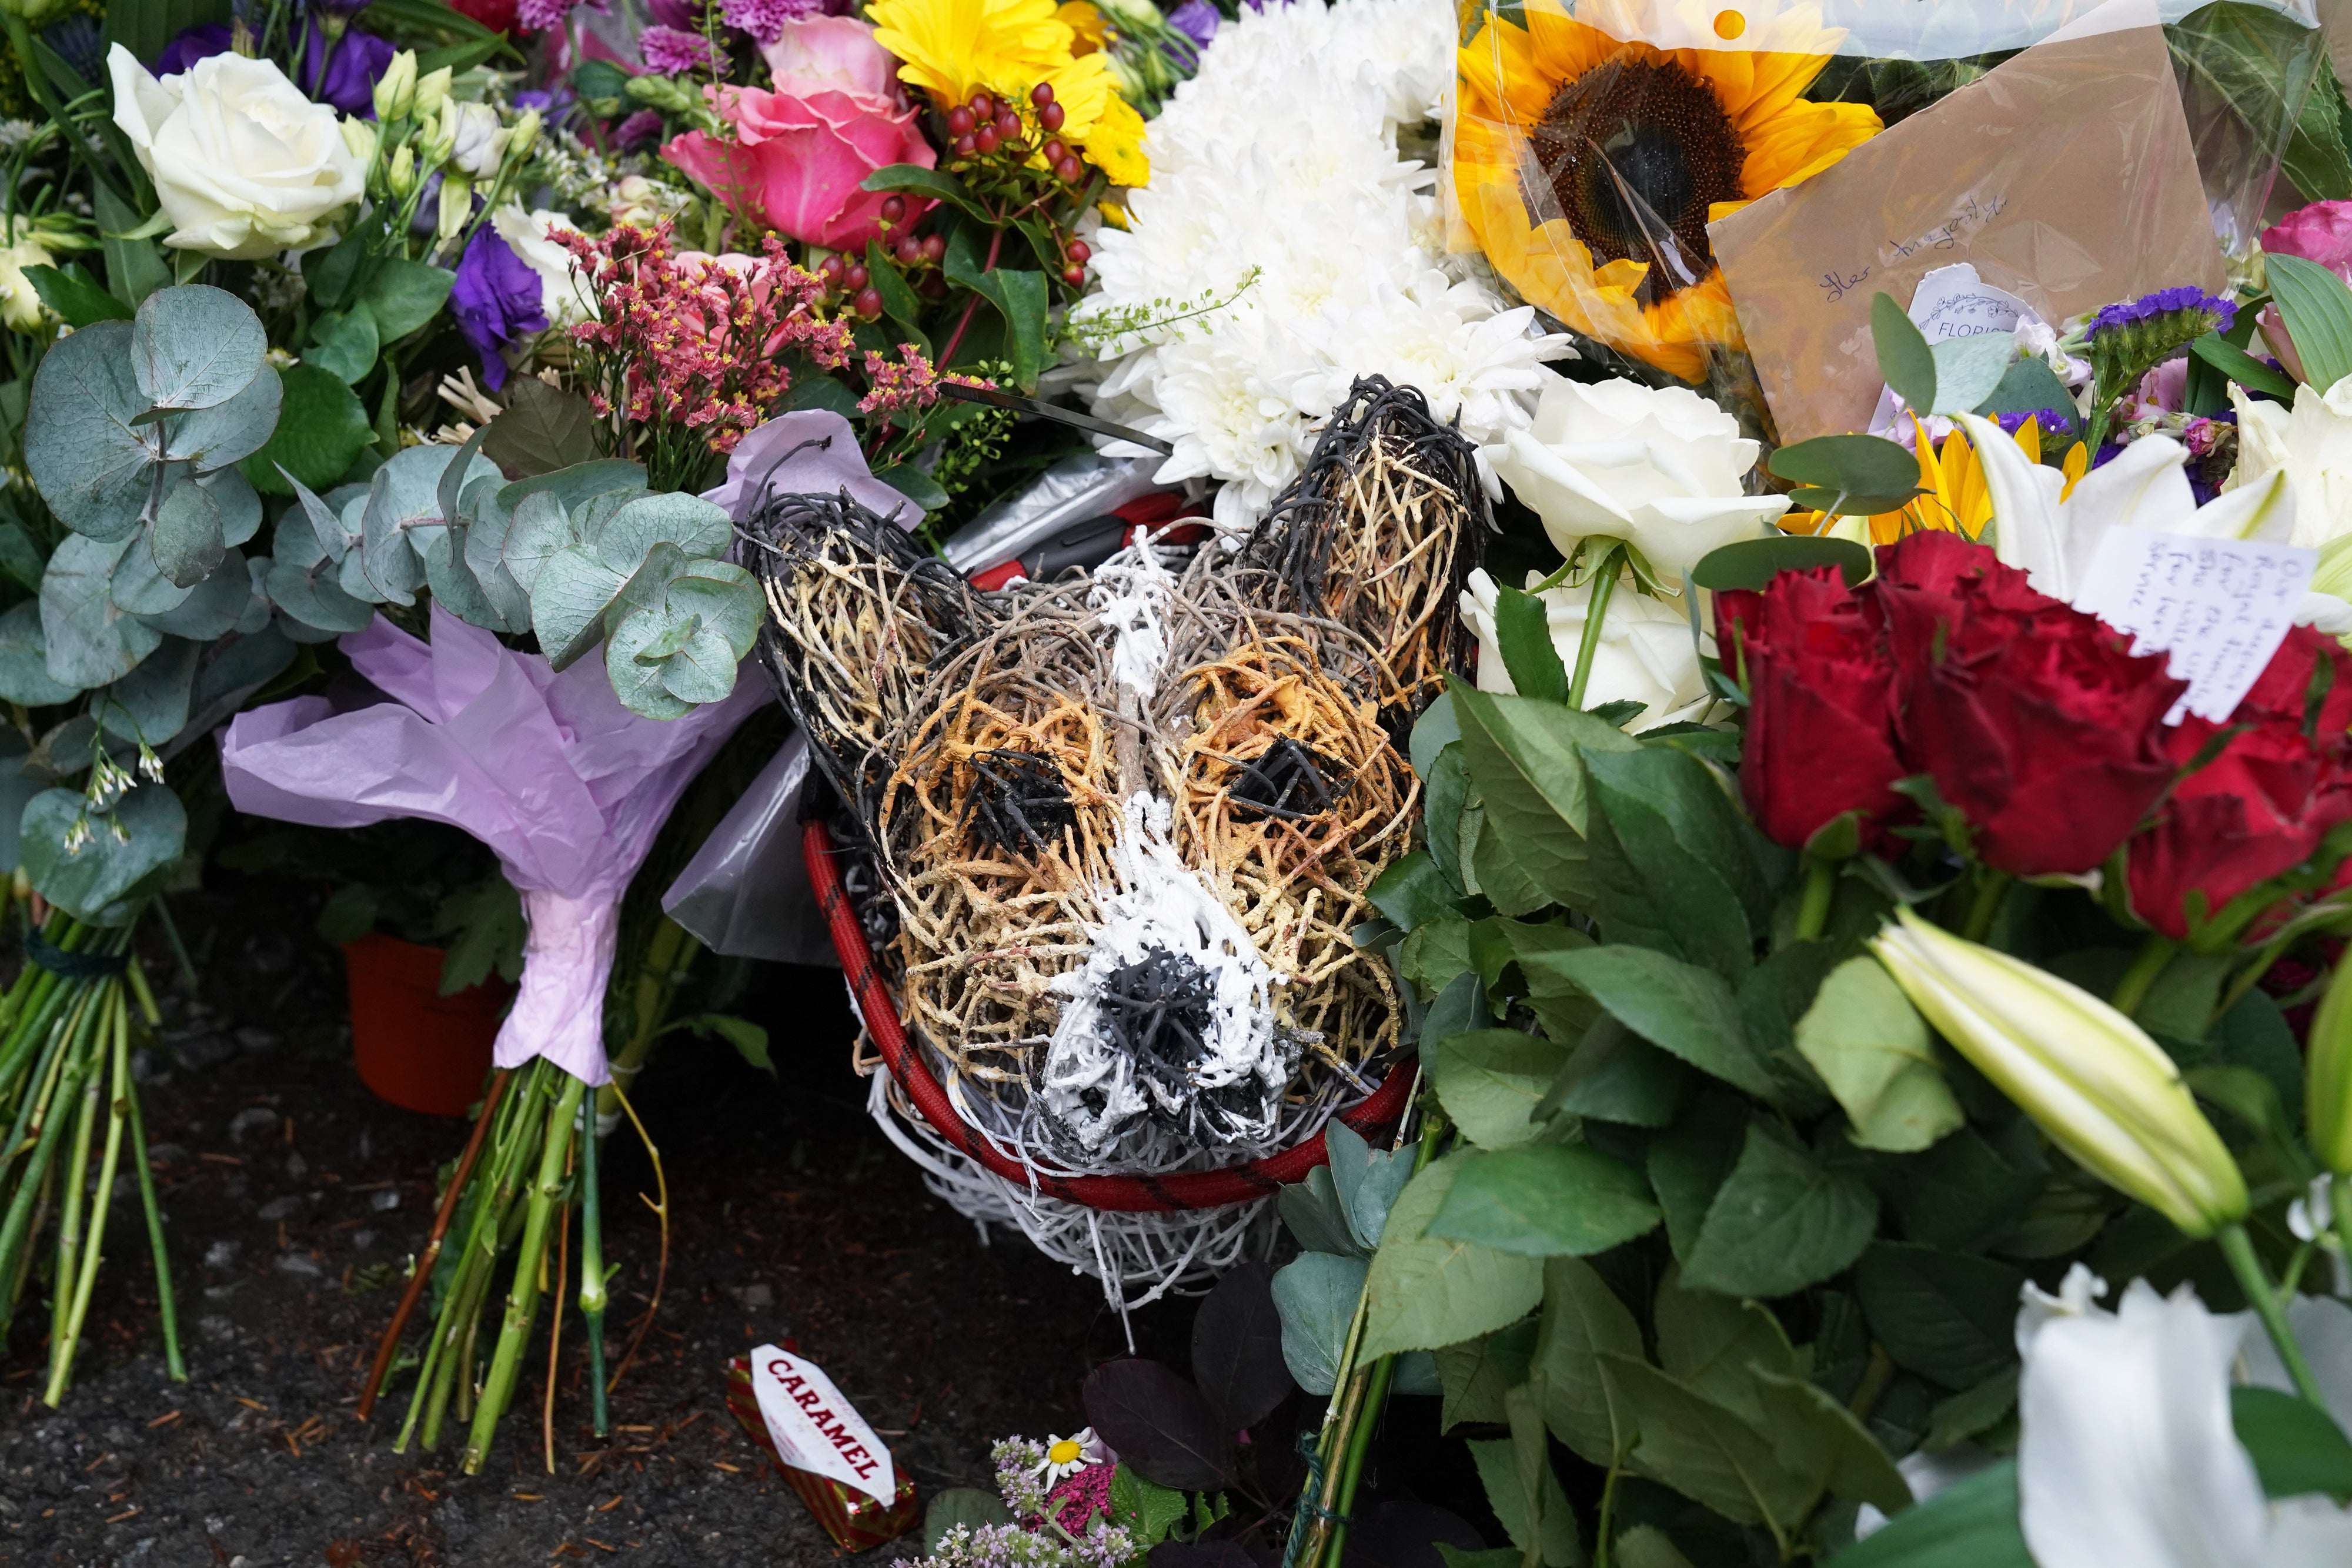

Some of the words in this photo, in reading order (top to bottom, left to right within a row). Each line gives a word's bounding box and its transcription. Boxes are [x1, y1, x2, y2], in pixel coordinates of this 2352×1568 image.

[1819, 267, 1870, 302] Her
[1938, 322, 2013, 337] FLOR
[768, 1359, 878, 1480] CARAMEL
